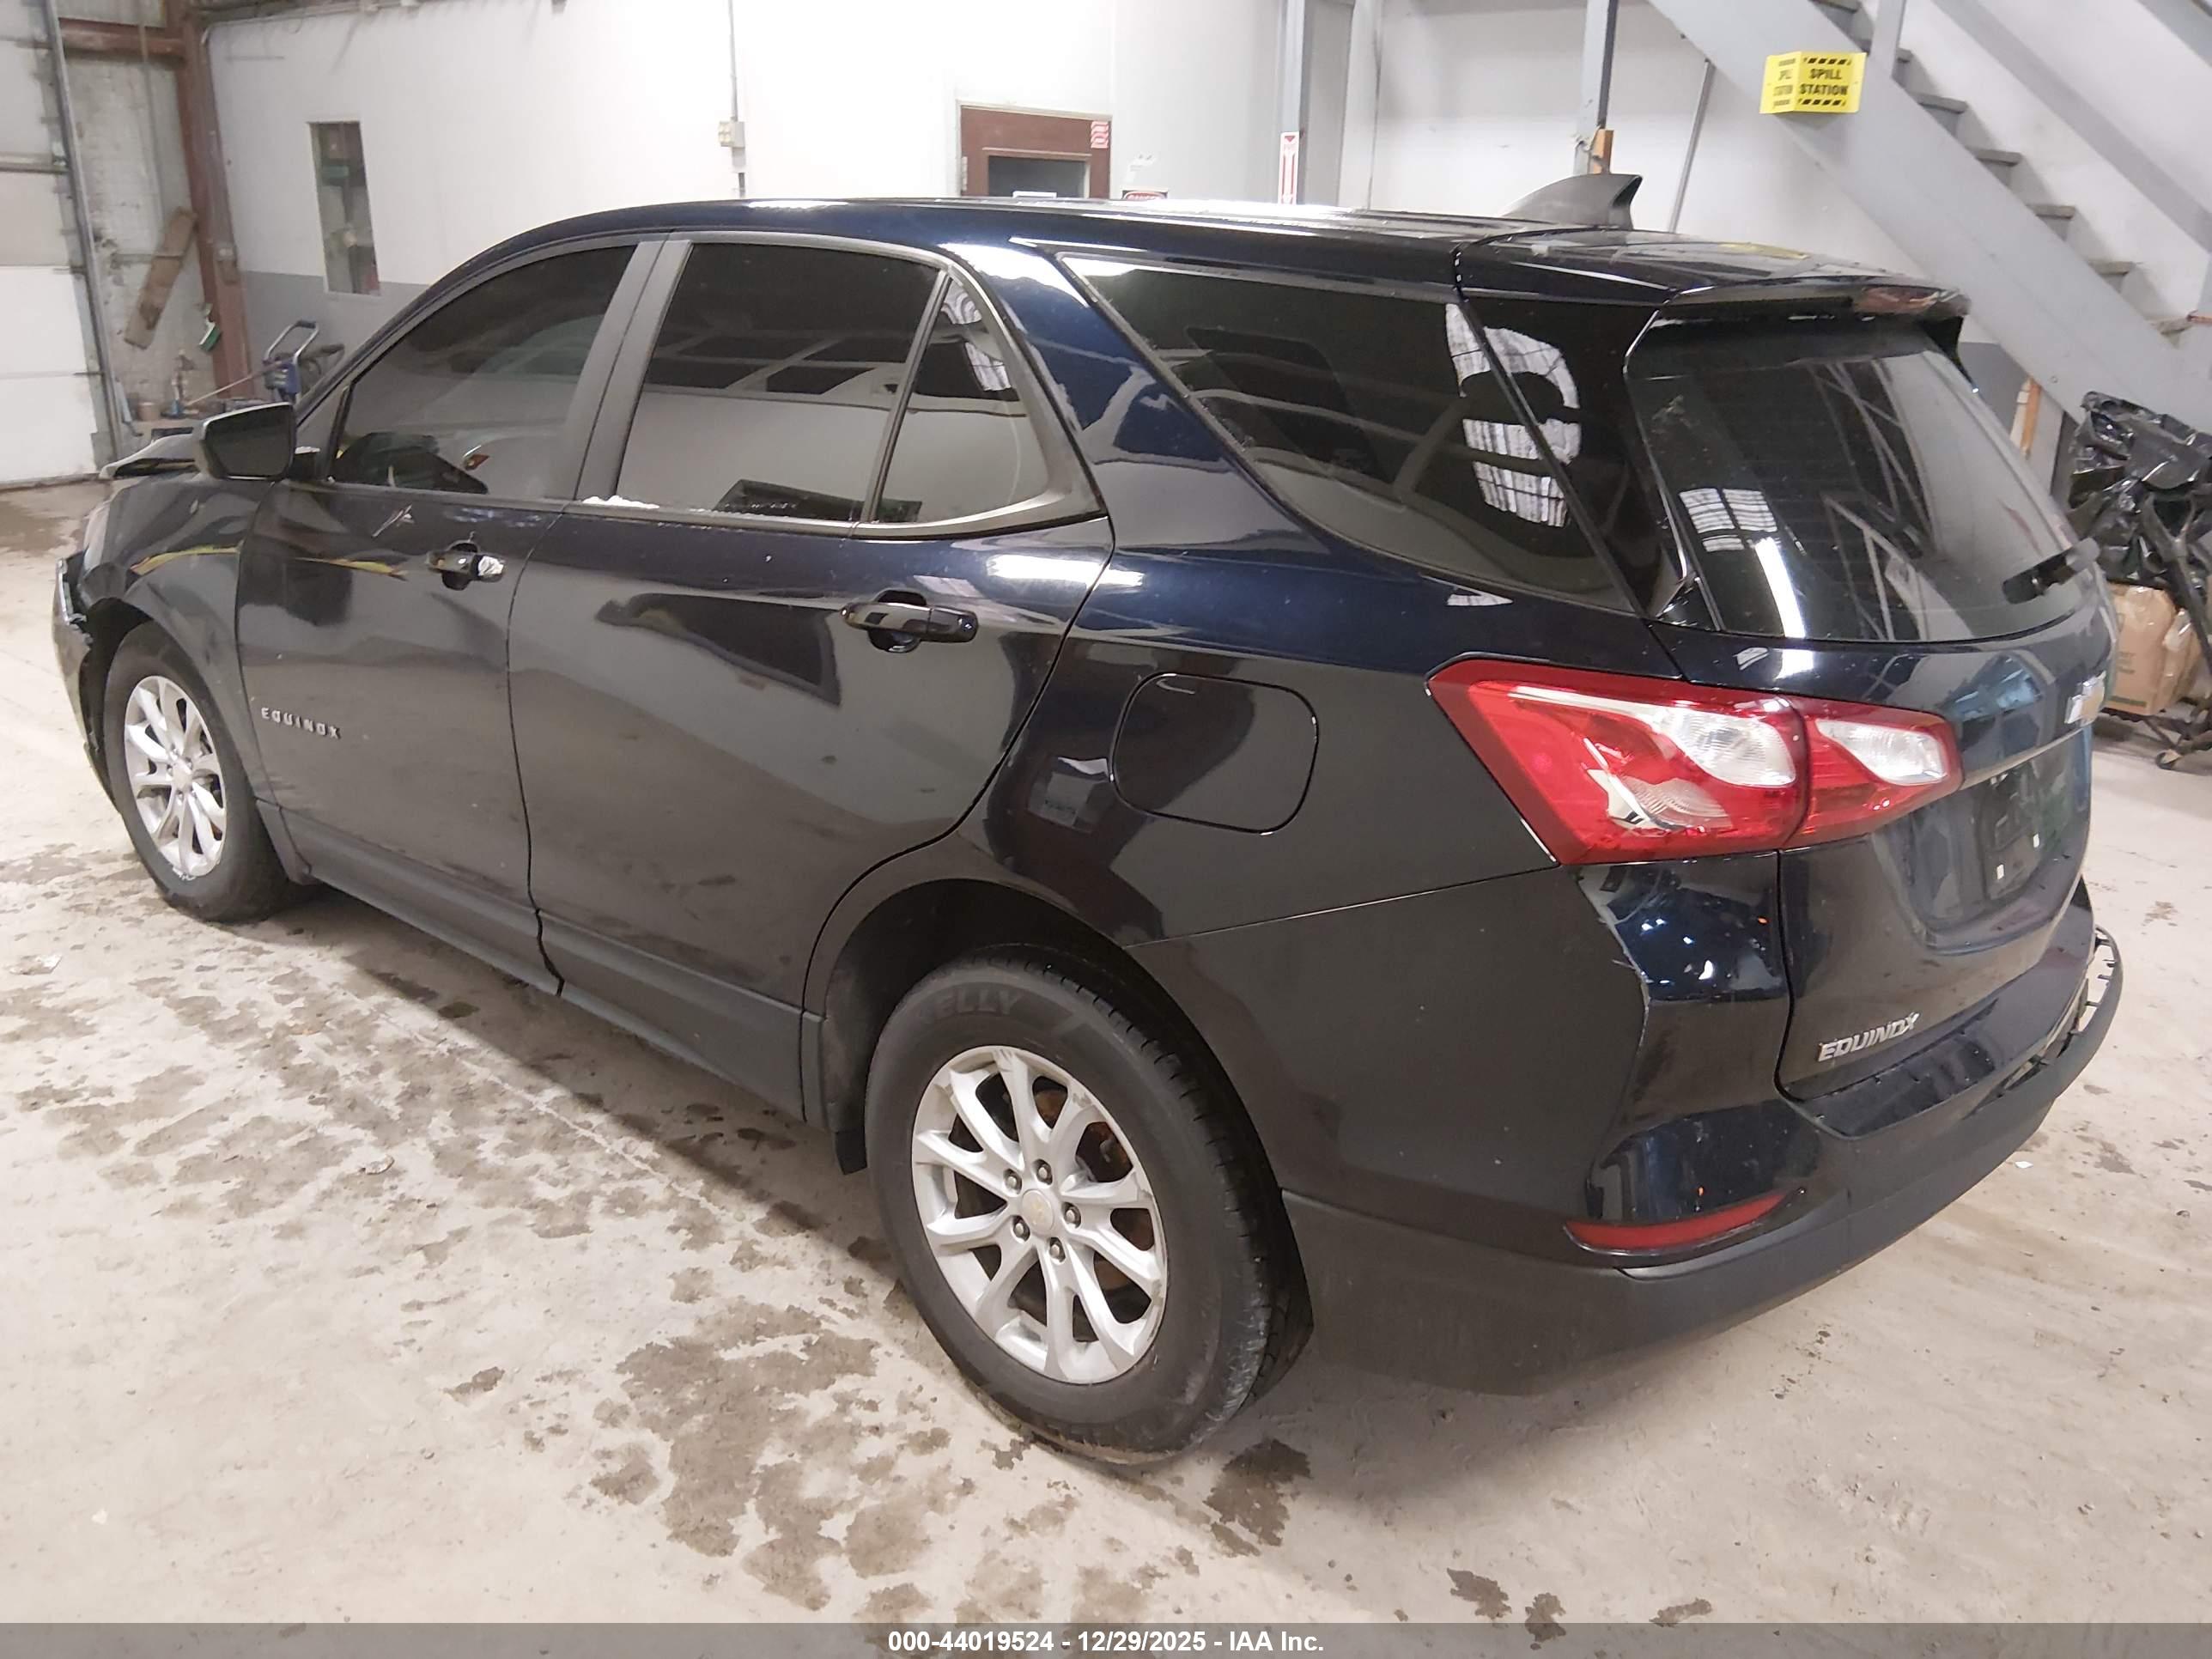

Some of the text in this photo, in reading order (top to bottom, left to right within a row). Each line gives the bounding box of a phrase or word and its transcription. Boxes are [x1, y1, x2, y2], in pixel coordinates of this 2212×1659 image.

[1809, 68, 1842, 80] SPILL
[1800, 83, 1849, 96] STATION
[261, 707, 340, 739] EQUINOX
[1817, 1012, 1920, 1062] EQUINOX
